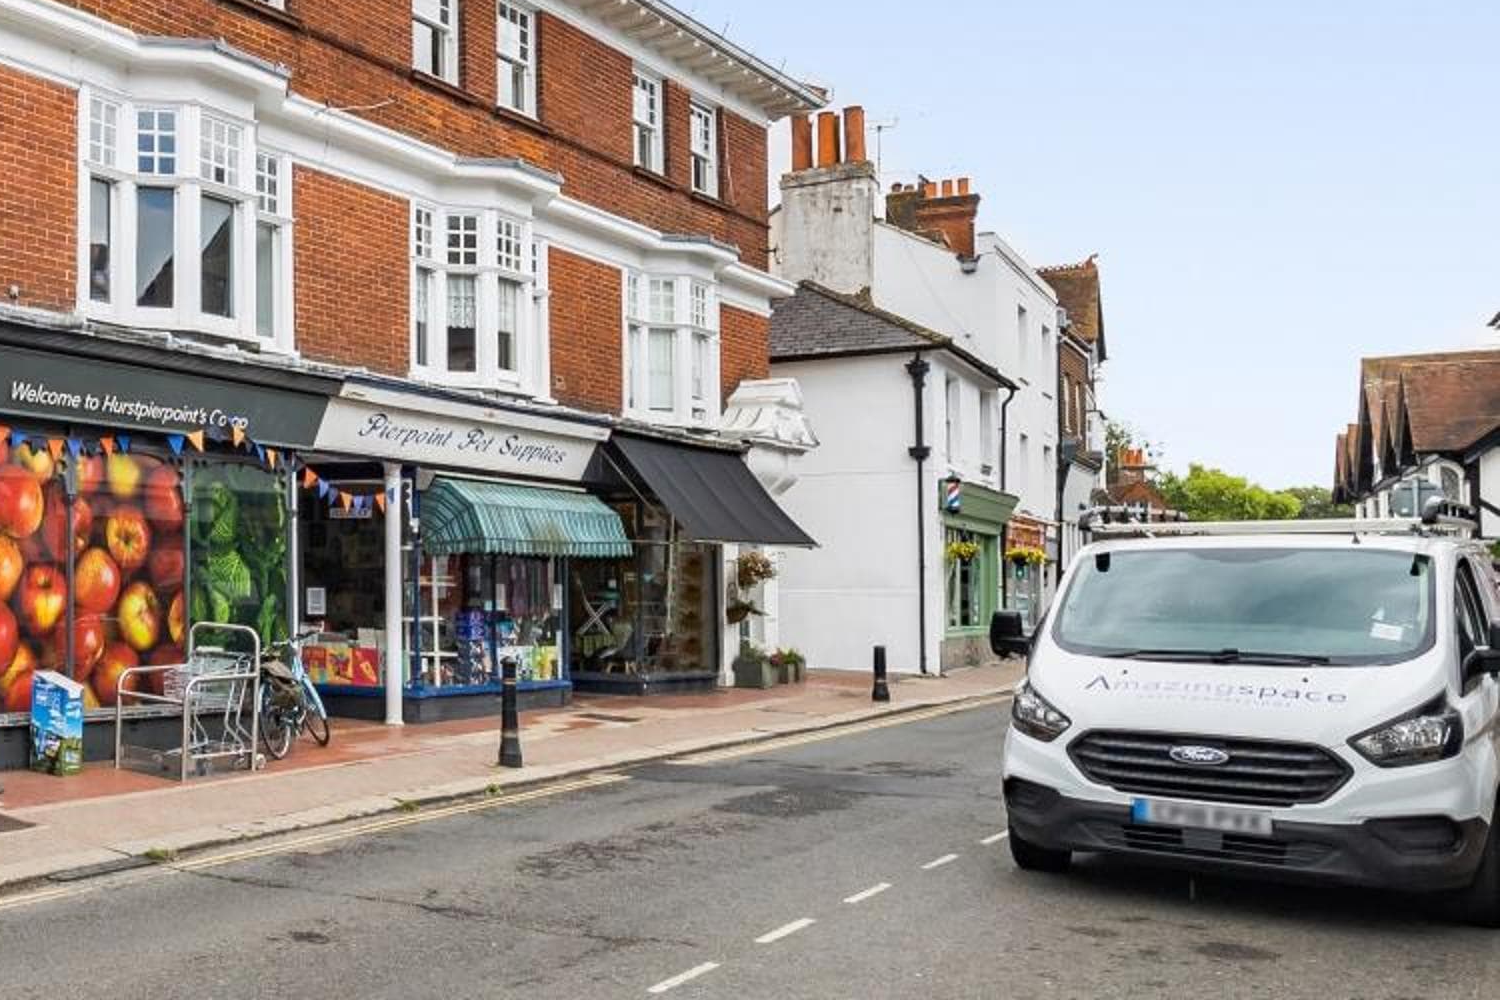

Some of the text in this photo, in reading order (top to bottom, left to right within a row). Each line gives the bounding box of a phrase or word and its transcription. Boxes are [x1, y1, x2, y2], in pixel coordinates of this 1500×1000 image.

[10, 380, 82, 409] Welcome
[84, 393, 100, 411] to
[101, 395, 207, 425] Hurstpierpoint's
[358, 412, 567, 464] Pierpoint Pet Supplies
